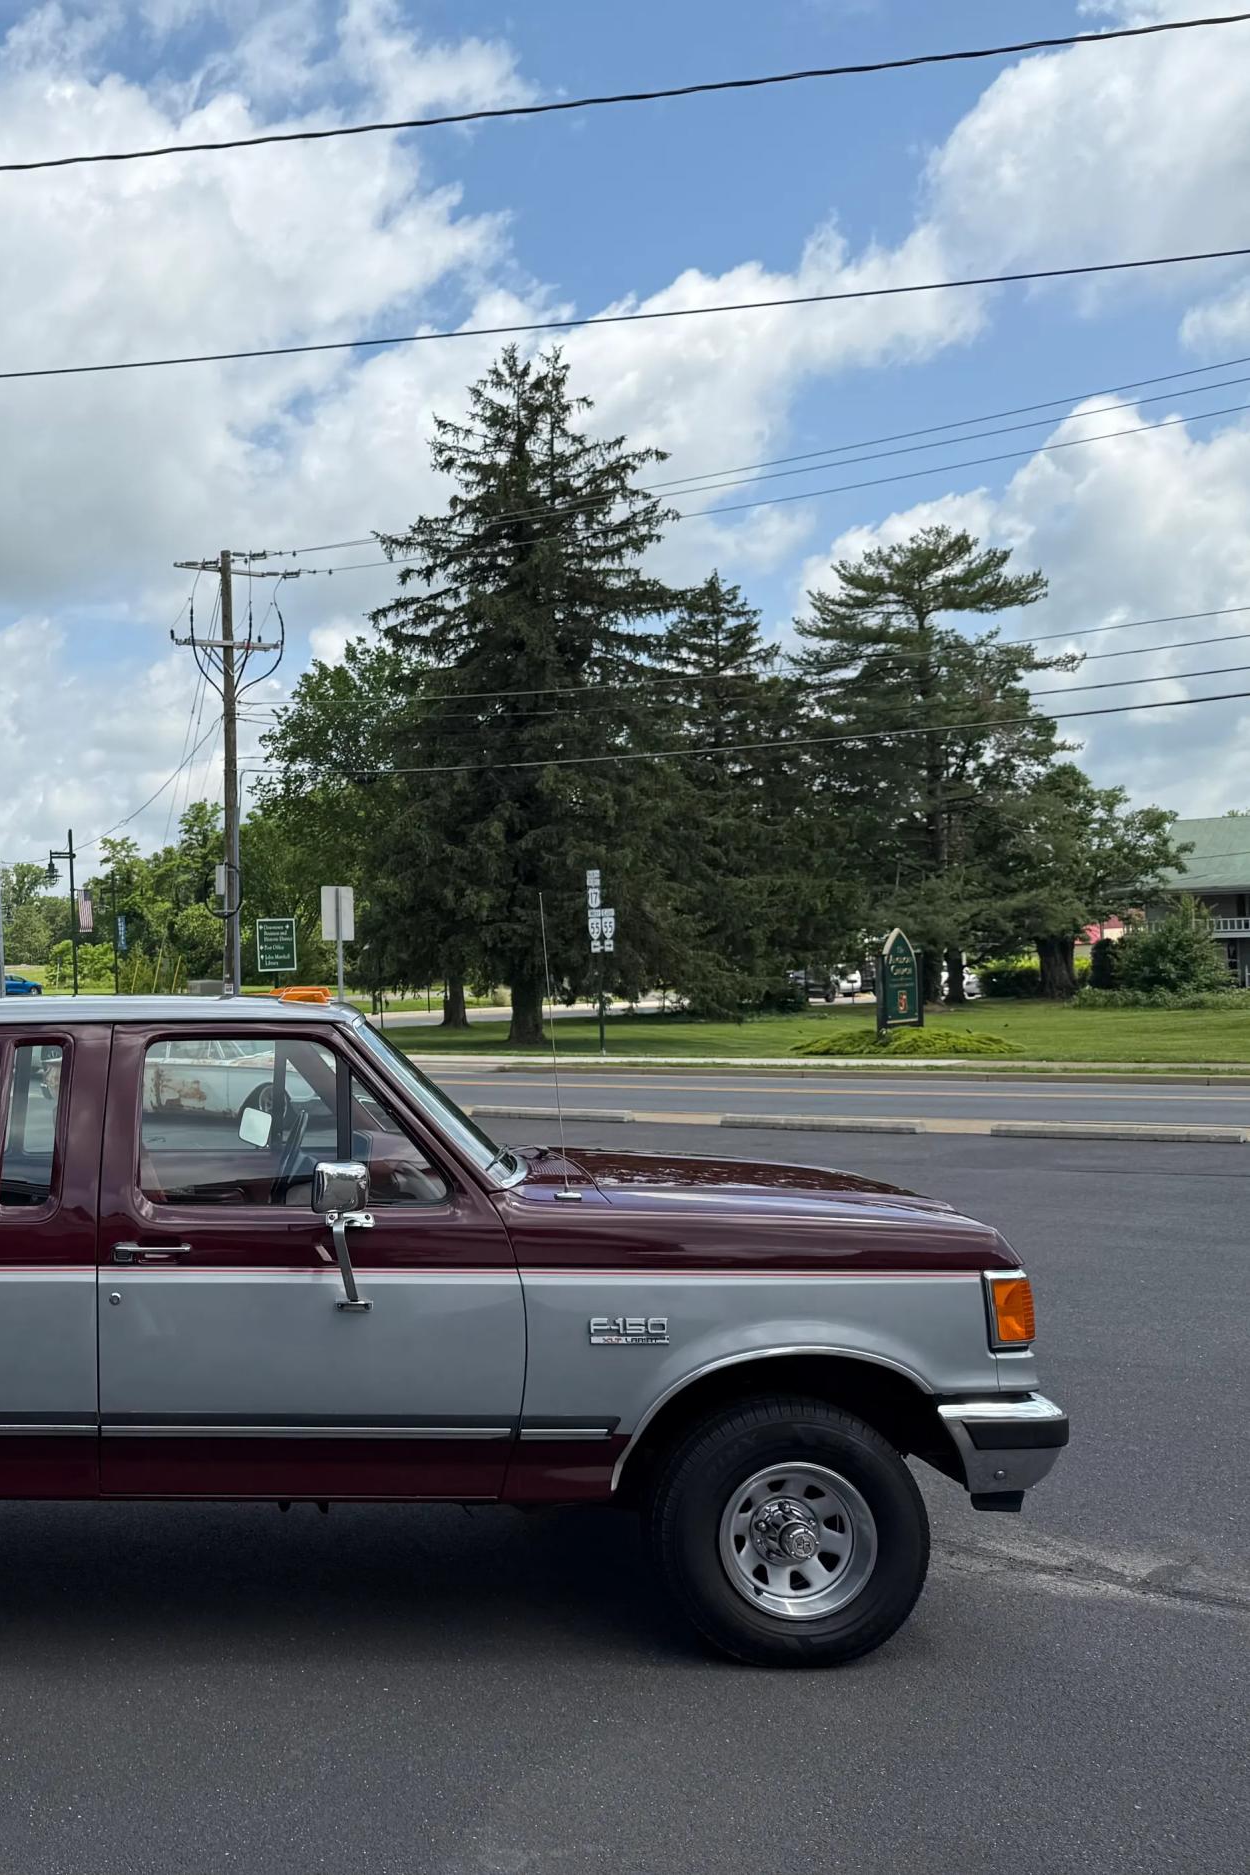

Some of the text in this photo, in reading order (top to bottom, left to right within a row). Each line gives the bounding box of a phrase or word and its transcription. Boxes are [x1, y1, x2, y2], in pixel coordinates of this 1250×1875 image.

[590, 892, 598, 905] 17
[590, 922, 600, 934] 55
[604, 921, 613, 933] 55
[590, 1317, 668, 1334] F-150
